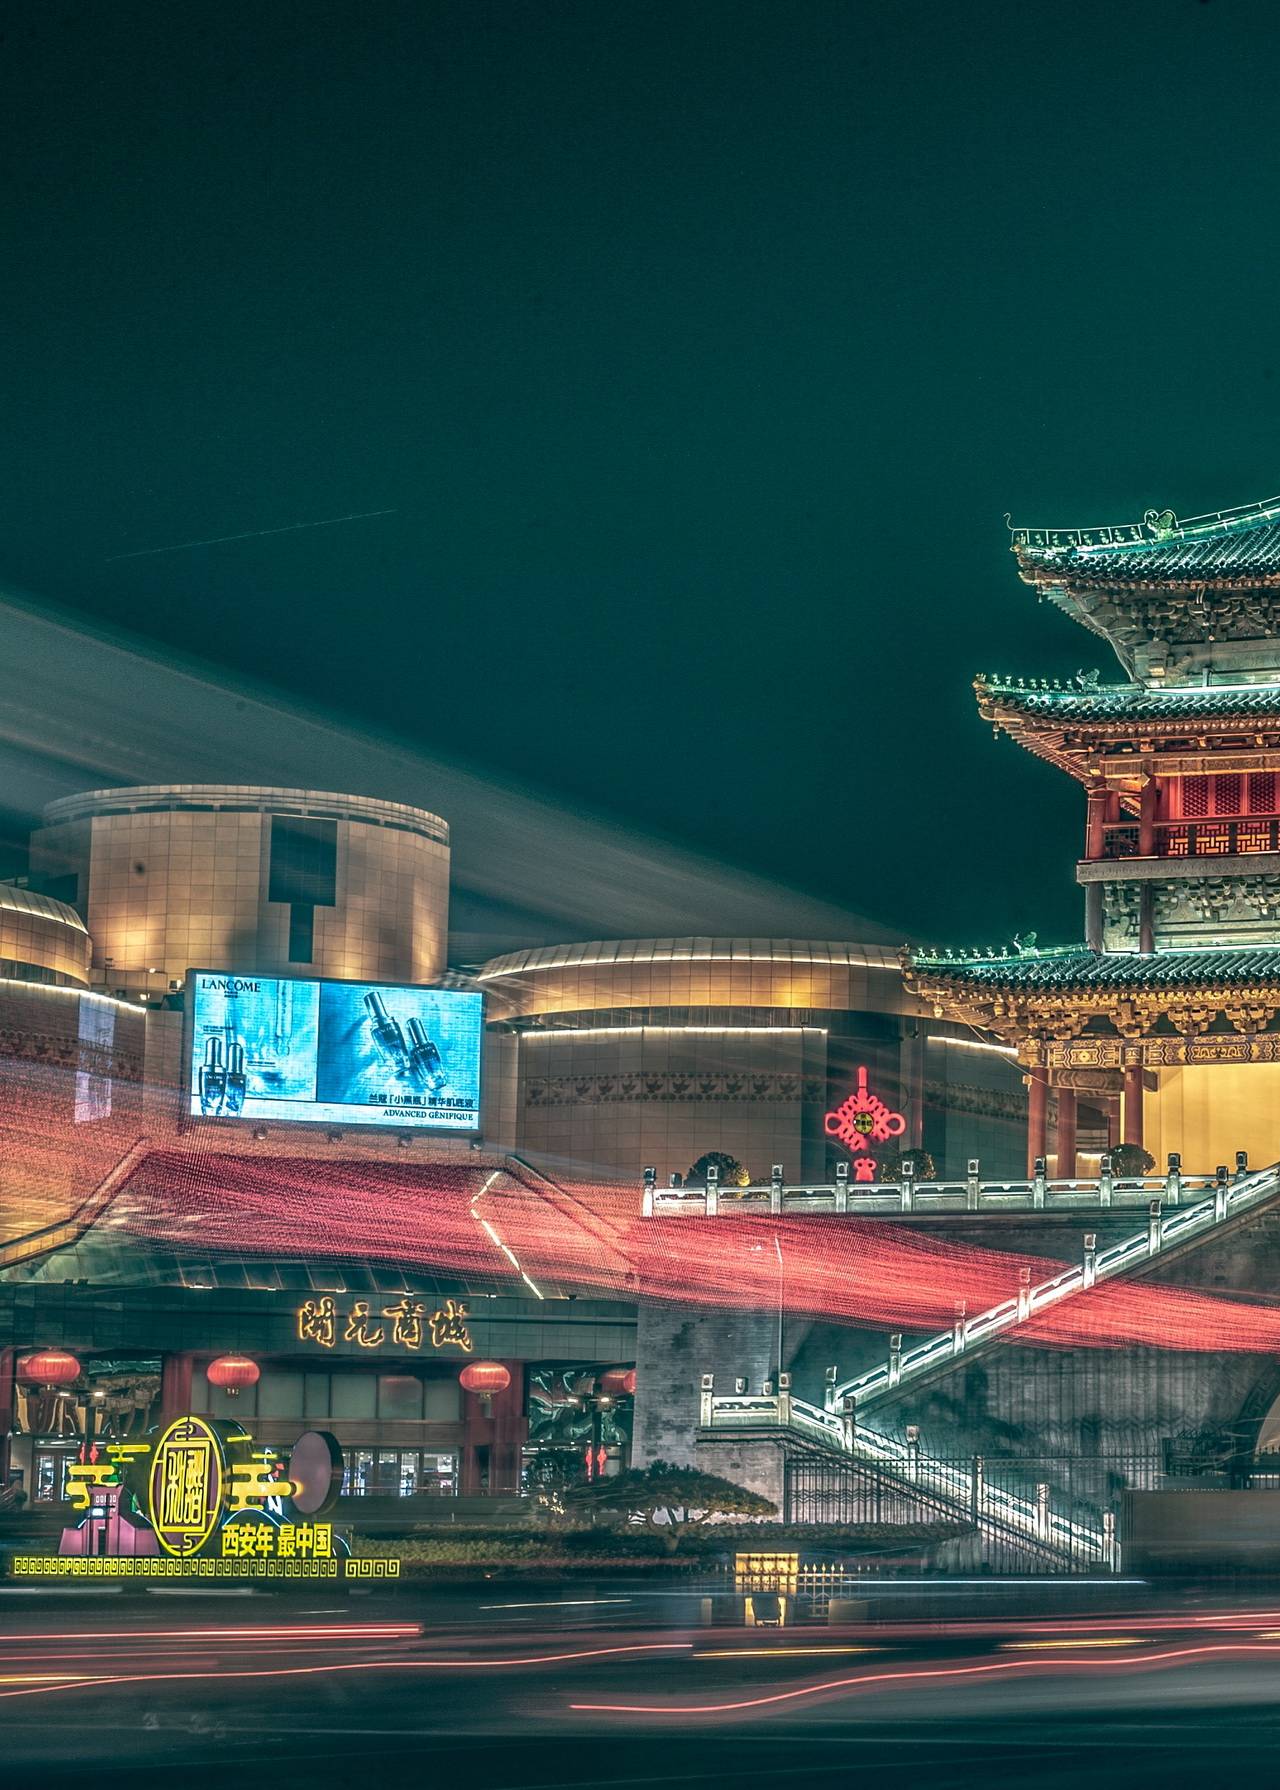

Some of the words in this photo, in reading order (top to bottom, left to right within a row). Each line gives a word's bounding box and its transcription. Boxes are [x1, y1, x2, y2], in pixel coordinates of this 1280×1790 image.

[202, 979, 261, 993] LANCÔME
[383, 1109, 427, 1119] ADVANCED
[221, 1522, 274, 1558] 西安年
[277, 1521, 332, 1558] 最中国
